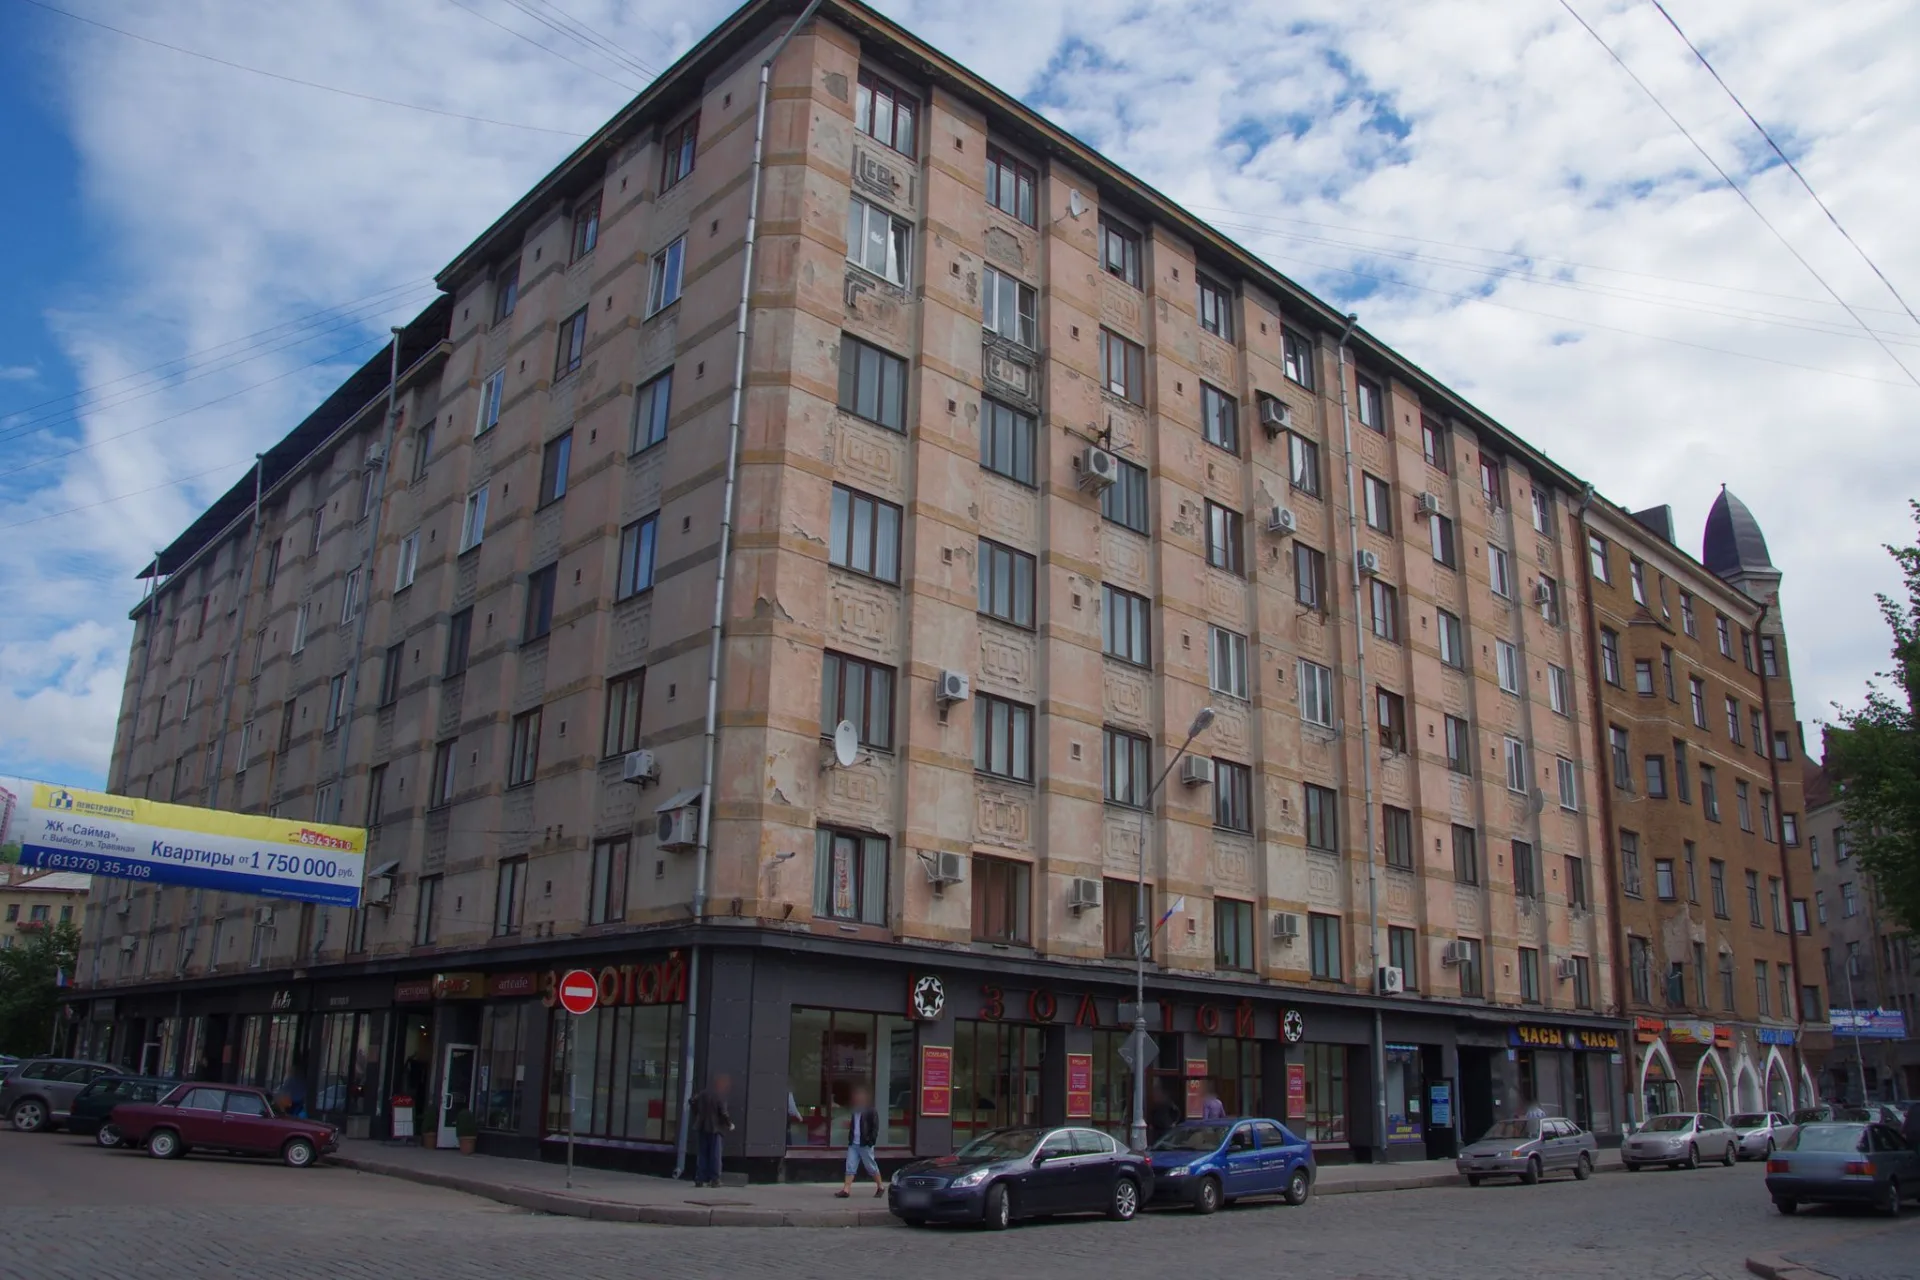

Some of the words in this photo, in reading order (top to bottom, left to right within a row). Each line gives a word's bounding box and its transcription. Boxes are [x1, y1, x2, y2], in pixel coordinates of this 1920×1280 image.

[44, 819, 64, 832] ЖК
[50, 834, 84, 847] Выборг,
[47, 853, 100, 873] (81378)
[102, 861, 152, 878] 35-108
[150, 839, 235, 867] Квартиры
[238, 855, 249, 865] от
[249, 851, 260, 869] 1
[266, 853, 300, 874] 750
[303, 857, 338, 878] 000
[338, 867, 355, 879] руб.
[541, 948, 687, 1008] ЗОТОЙ
[979, 983, 1257, 1039] ЗОЛТОЙ
[1519, 1026, 1562, 1045] ЧАСЫ
[1580, 1031, 1619, 1048] ЧАСЫ
